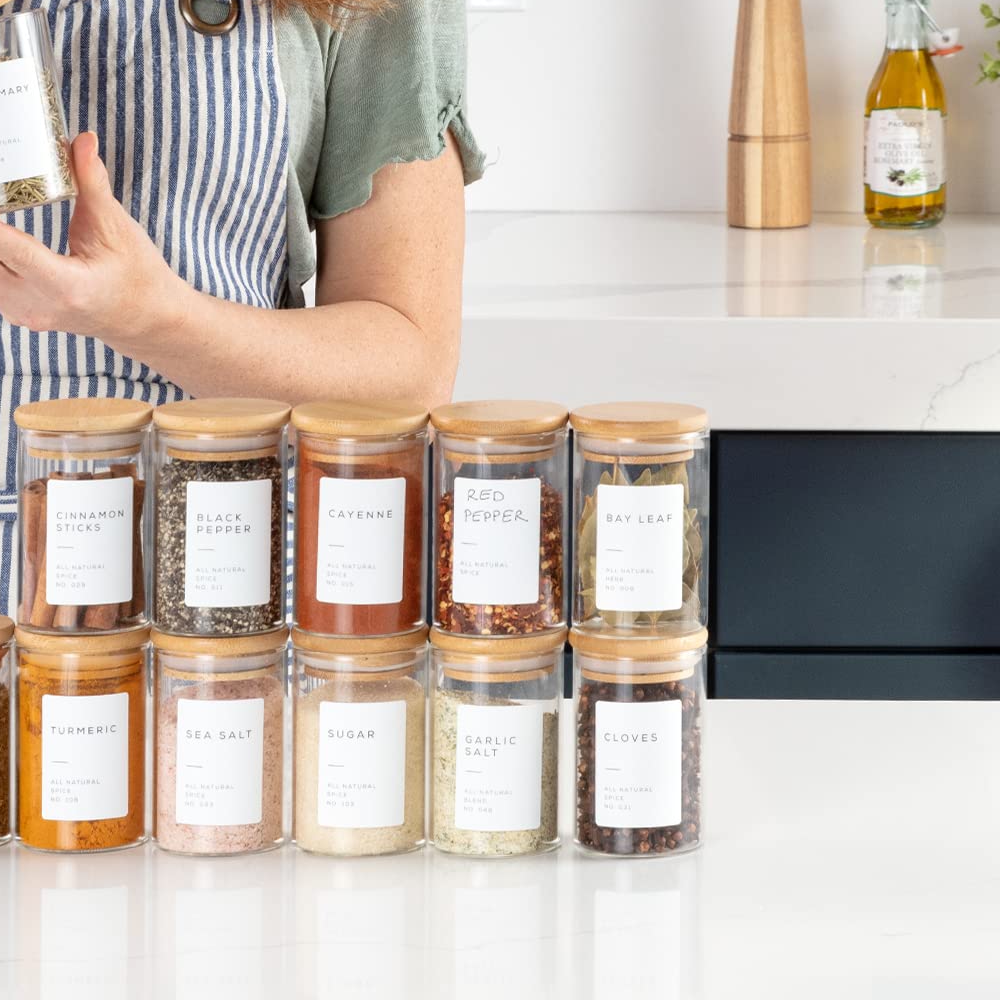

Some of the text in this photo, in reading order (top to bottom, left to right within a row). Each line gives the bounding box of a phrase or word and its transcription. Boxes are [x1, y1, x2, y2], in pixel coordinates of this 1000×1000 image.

[468, 489, 505, 502] RED
[56, 509, 124, 520] CINNAMON
[196, 513, 242, 523] BLACK
[329, 509, 393, 520] CAYENNE
[464, 509, 529, 523] PEPPER
[606, 513, 673, 524] BAY LEAF
[56, 523, 101, 532] STICKS
[196, 524, 251, 534] PEPPER
[50, 724, 117, 735] TURMERIC
[186, 729, 252, 740] SEA SALT
[327, 729, 375, 739] SUGAR
[465, 736, 517, 746] GARLIC
[604, 732, 658, 743] CLOVES
[465, 747, 498, 757] SALT
